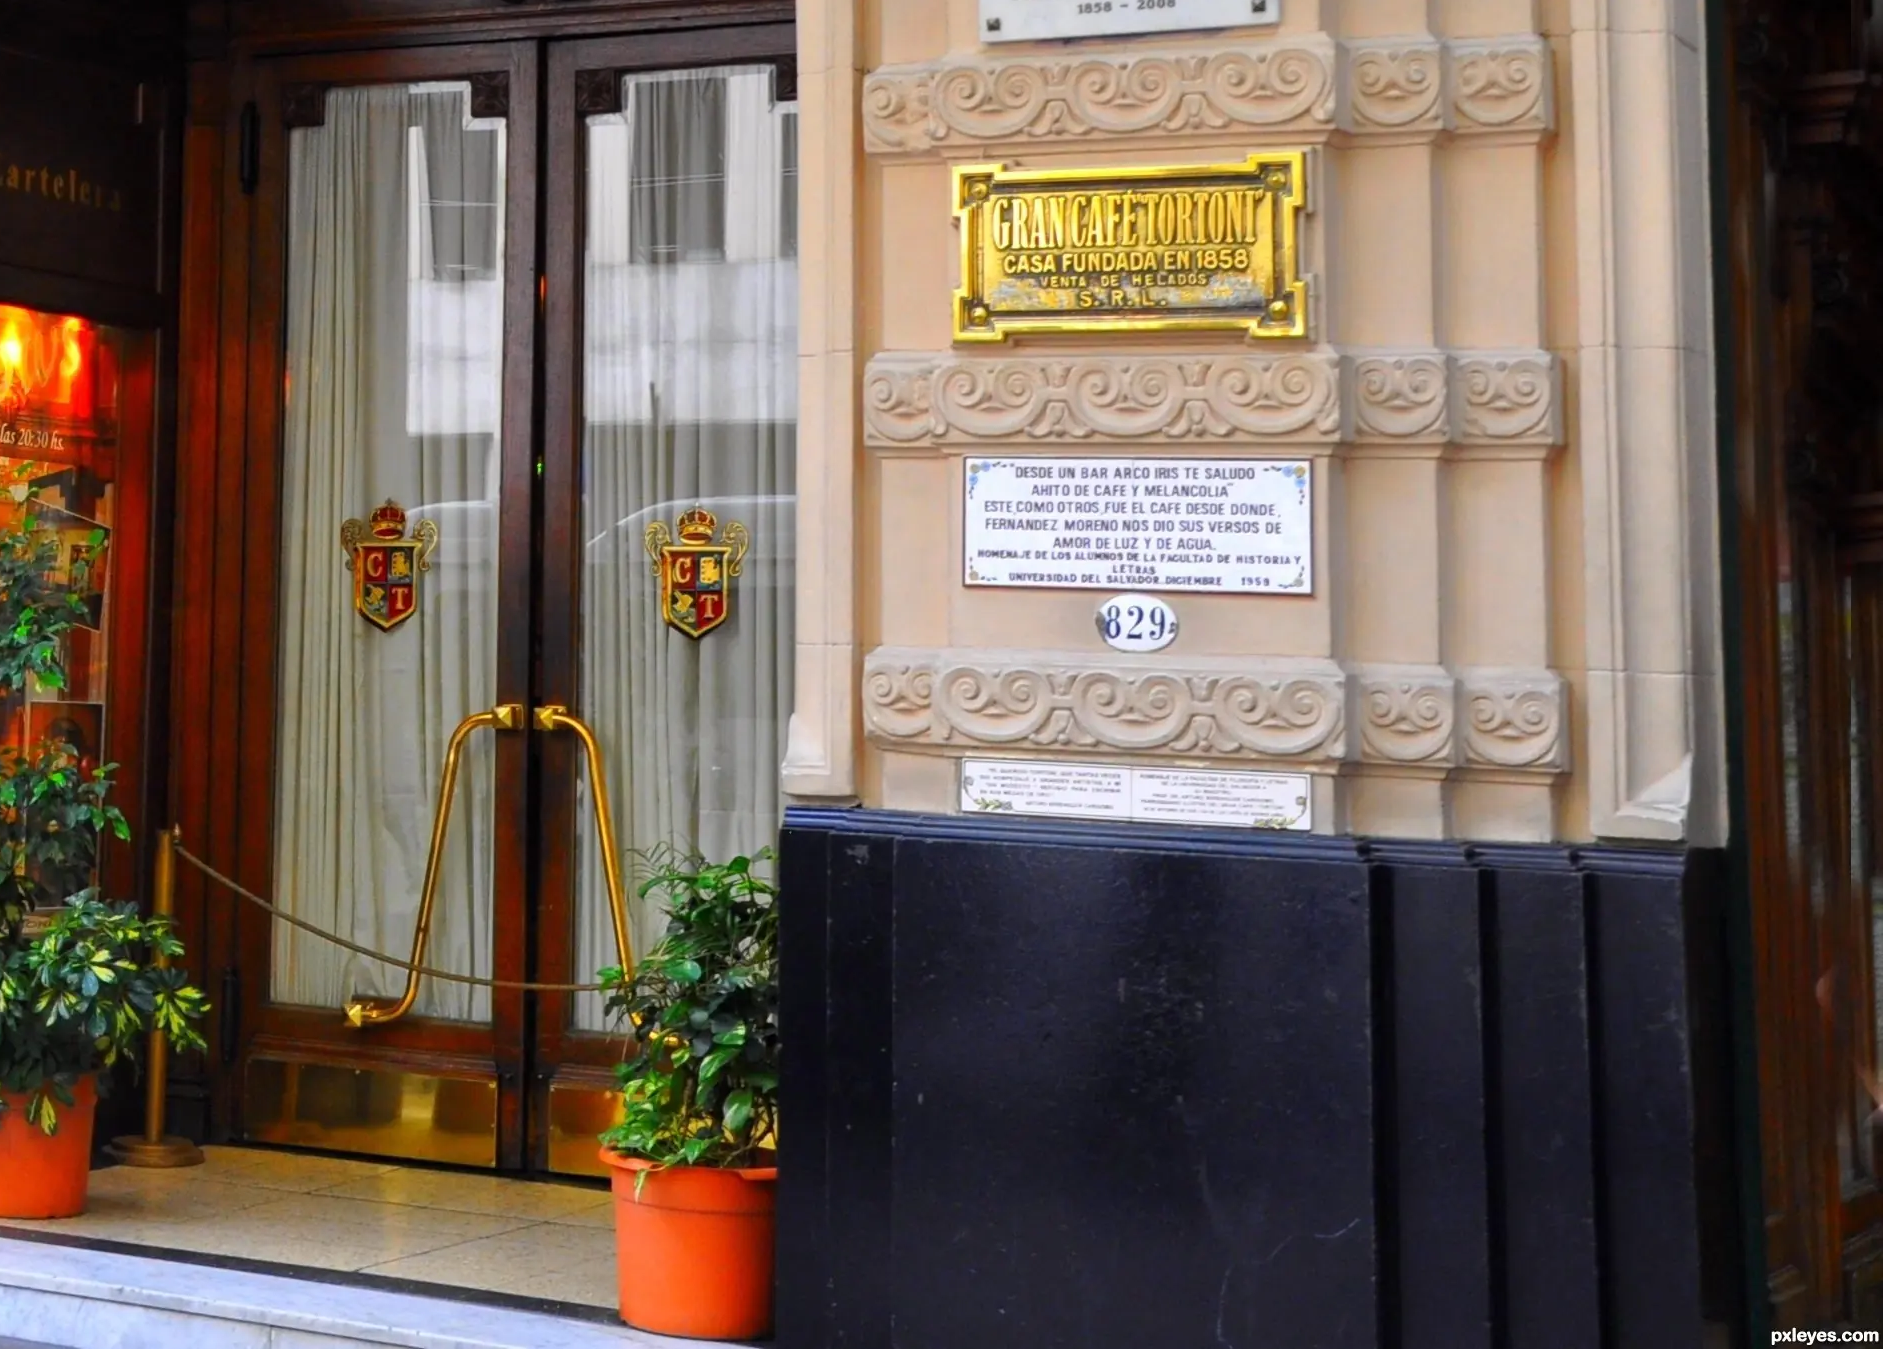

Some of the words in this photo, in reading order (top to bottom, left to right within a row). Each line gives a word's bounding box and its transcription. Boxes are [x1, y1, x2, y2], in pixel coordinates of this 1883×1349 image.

[1077, 2, 1112, 14] 1858
[992, 197, 1066, 250] GRAN
[1003, 254, 1056, 273] CASA
[1062, 252, 1157, 273] FUNDADA
[1166, 251, 1192, 270] EN
[1197, 249, 1249, 269] 1858
[1041, 275, 1087, 287] VENTA
[1101, 275, 1119, 287] DE
[1132, 273, 1207, 286] HELADOS
[0, 423, 15, 445] las
[18, 428, 48, 449] 20:30
[1058, 467, 1075, 479] UN
[1081, 467, 1108, 479] BAR
[1113, 468, 1150, 480] ARCO
[1154, 467, 1179, 479] IRIS
[1184, 467, 1199, 479] TE
[1205, 467, 1255, 480] SALUDO
[1031, 485, 1070, 496] AHITO
[1074, 485, 1090, 496] DE
[1094, 485, 1127, 497] CAFE
[1132, 485, 1139, 496] Y
[1016, 501, 1054, 513] COMO
[1104, 502, 1128, 514] FUE
[1131, 502, 1144, 514] EL
[1150, 502, 1181, 514] CAFE
[1186, 503, 1225, 515] DESDE
[985, 518, 1058, 531] FERNANDEZ
[1064, 519, 1118, 531] MORENO
[1122, 520, 1149, 532] NOS
[1153, 520, 1174, 532] DIO
[1179, 520, 1204, 532] SUS
[1208, 521, 1260, 534] VERSOS
[1265, 522, 1282, 534] DE
[1053, 537, 1091, 549] AMOR
[1095, 537, 1111, 549] DE
[1115, 538, 1139, 550] LUZ
[1144, 538, 1152, 550] Y
[1157, 538, 1172, 550] DE
[977, 549, 1031, 559] HOMENAJE
[1035, 550, 1048, 559] DE
[1051, 551, 1071, 560] LOS
[1127, 553, 1139, 562] DE
[1143, 554, 1156, 562] LA
[1217, 554, 1230, 563] DE
[1236, 555, 1291, 565] HISTORIA
[1293, 555, 1301, 565] Y
[1009, 572, 1077, 582] UNIVERSIDAD
[1081, 574, 1101, 583] DEL
[391, 586, 409, 611] T
[699, 593, 719, 619] T
[1105, 604, 1165, 640] 829
